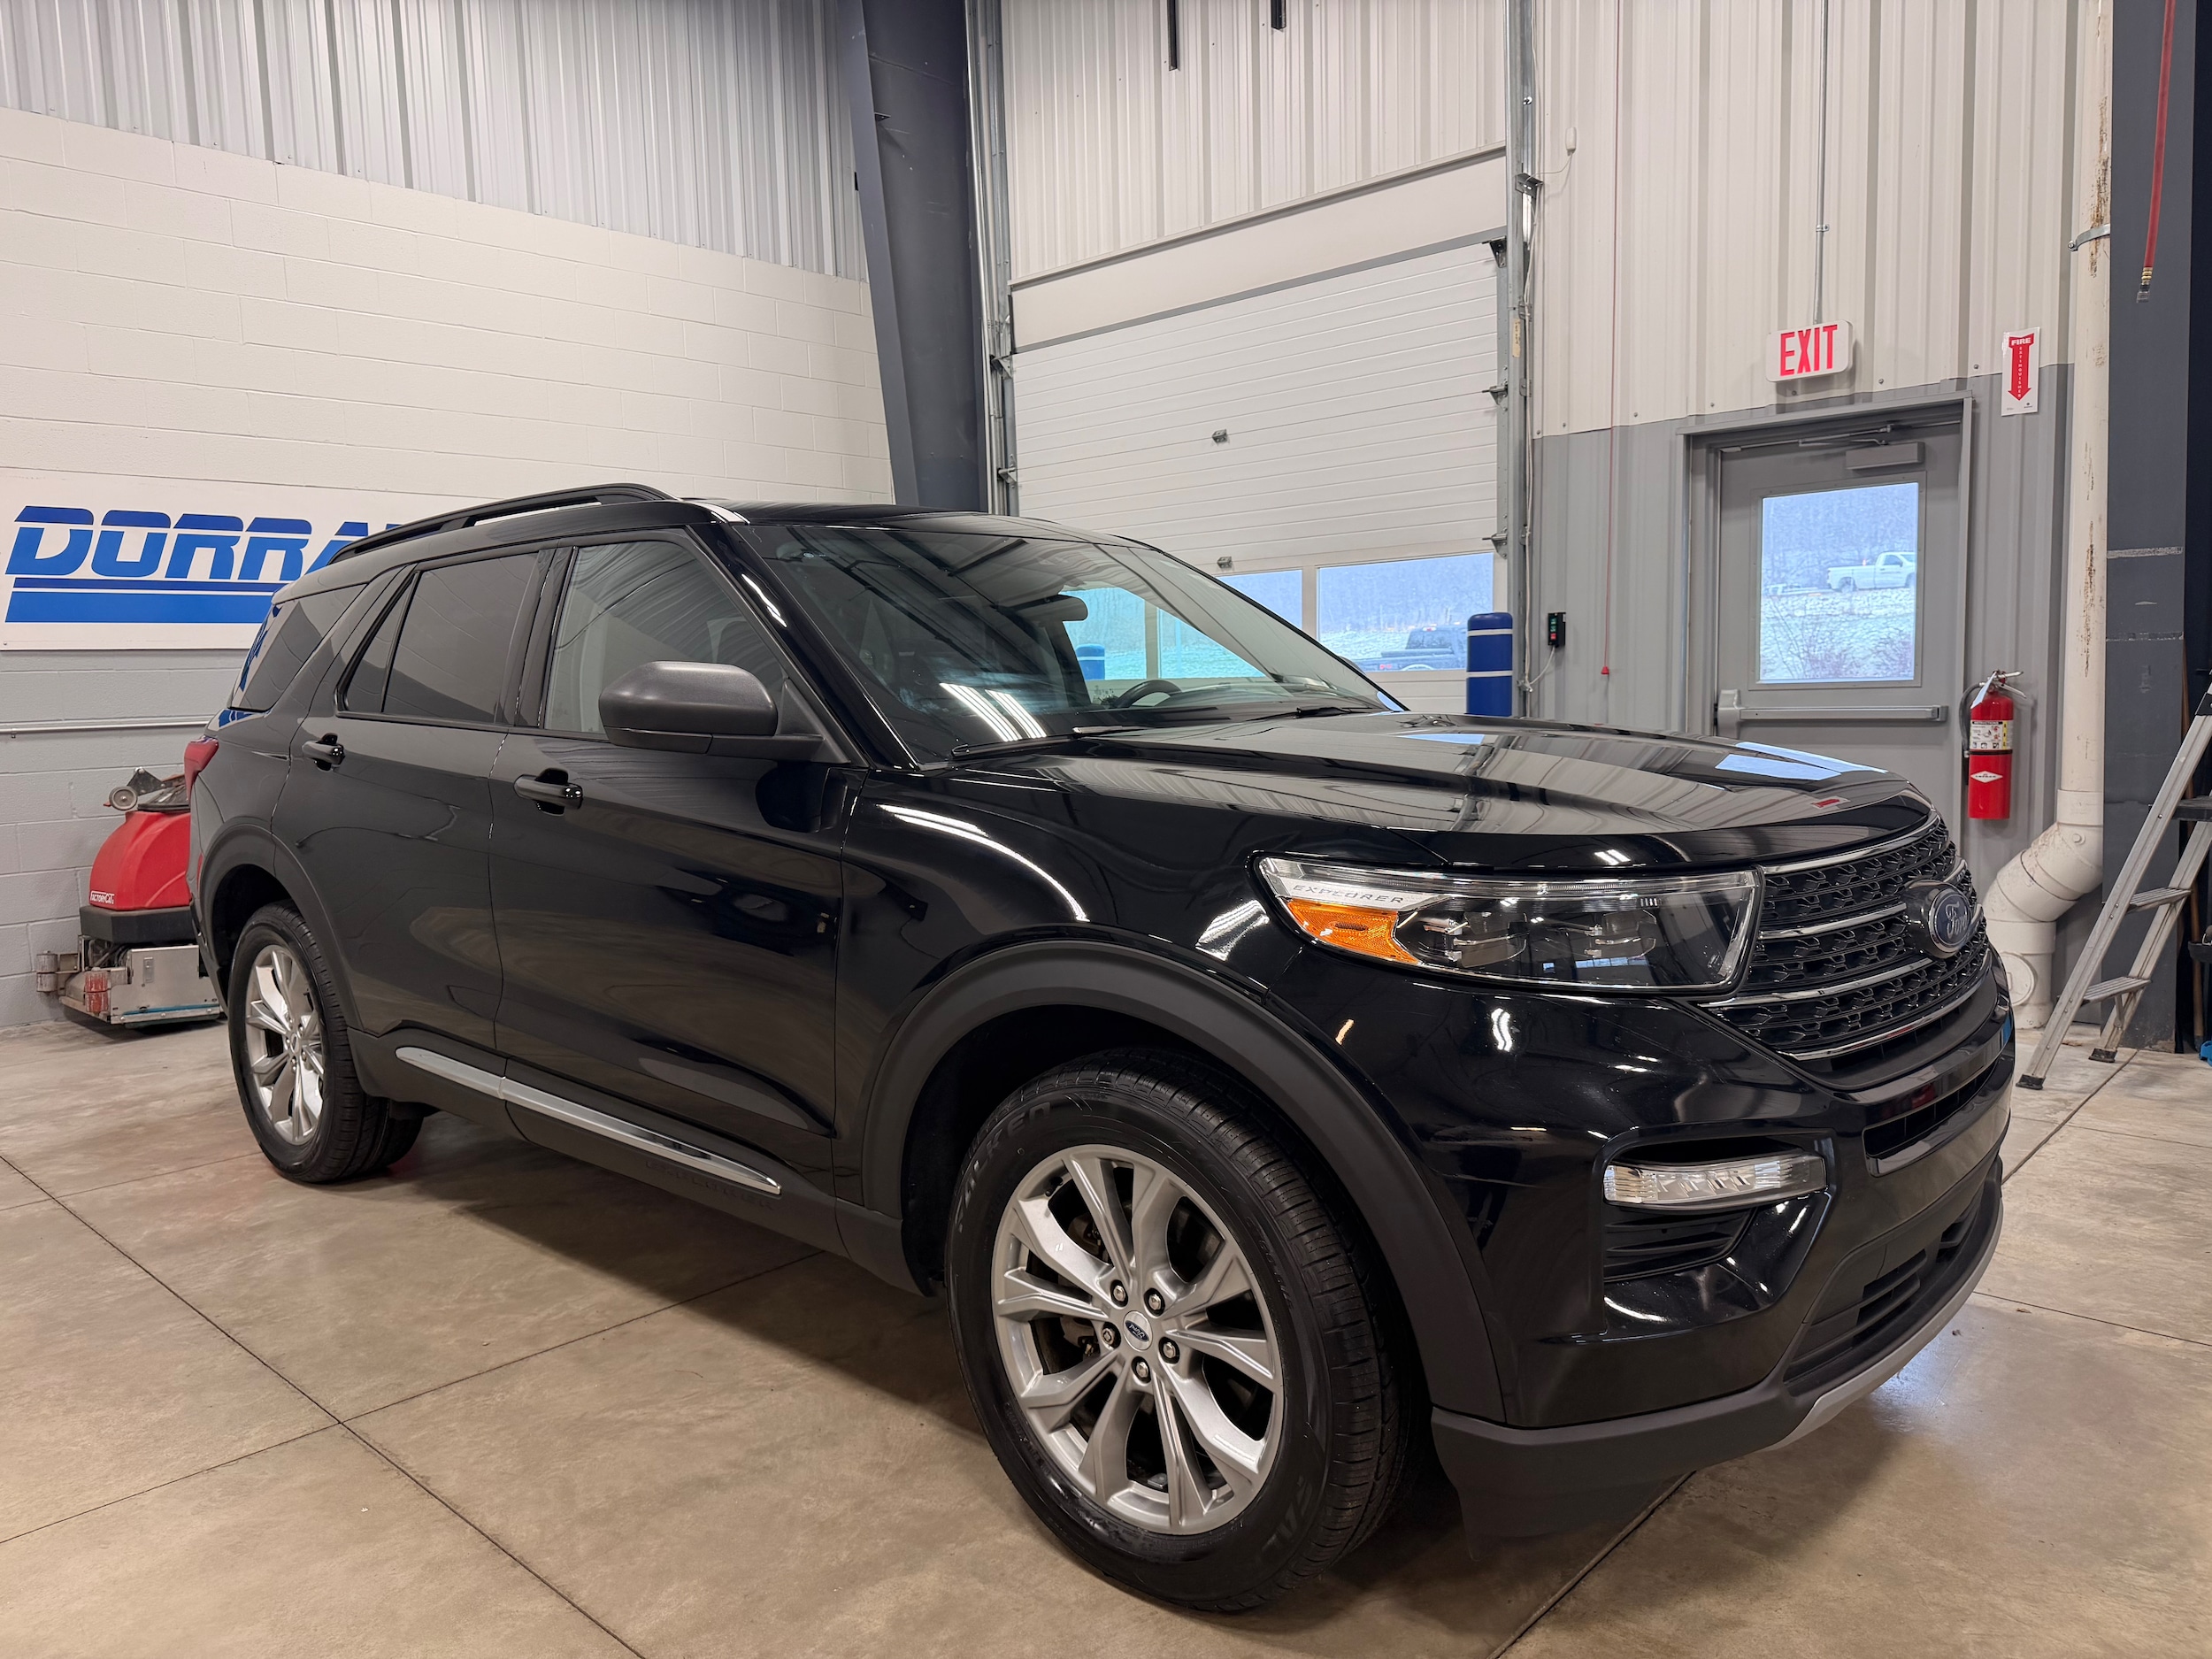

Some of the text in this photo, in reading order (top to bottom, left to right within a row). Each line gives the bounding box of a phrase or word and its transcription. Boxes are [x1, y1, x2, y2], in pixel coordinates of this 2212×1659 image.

[1780, 324, 1838, 377] EXIT
[2011, 337, 2032, 346] FIRE
[5, 505, 404, 580] DORRA
[1293, 885, 1404, 903] EXPLORER
[1945, 901, 1967, 939] Ford
